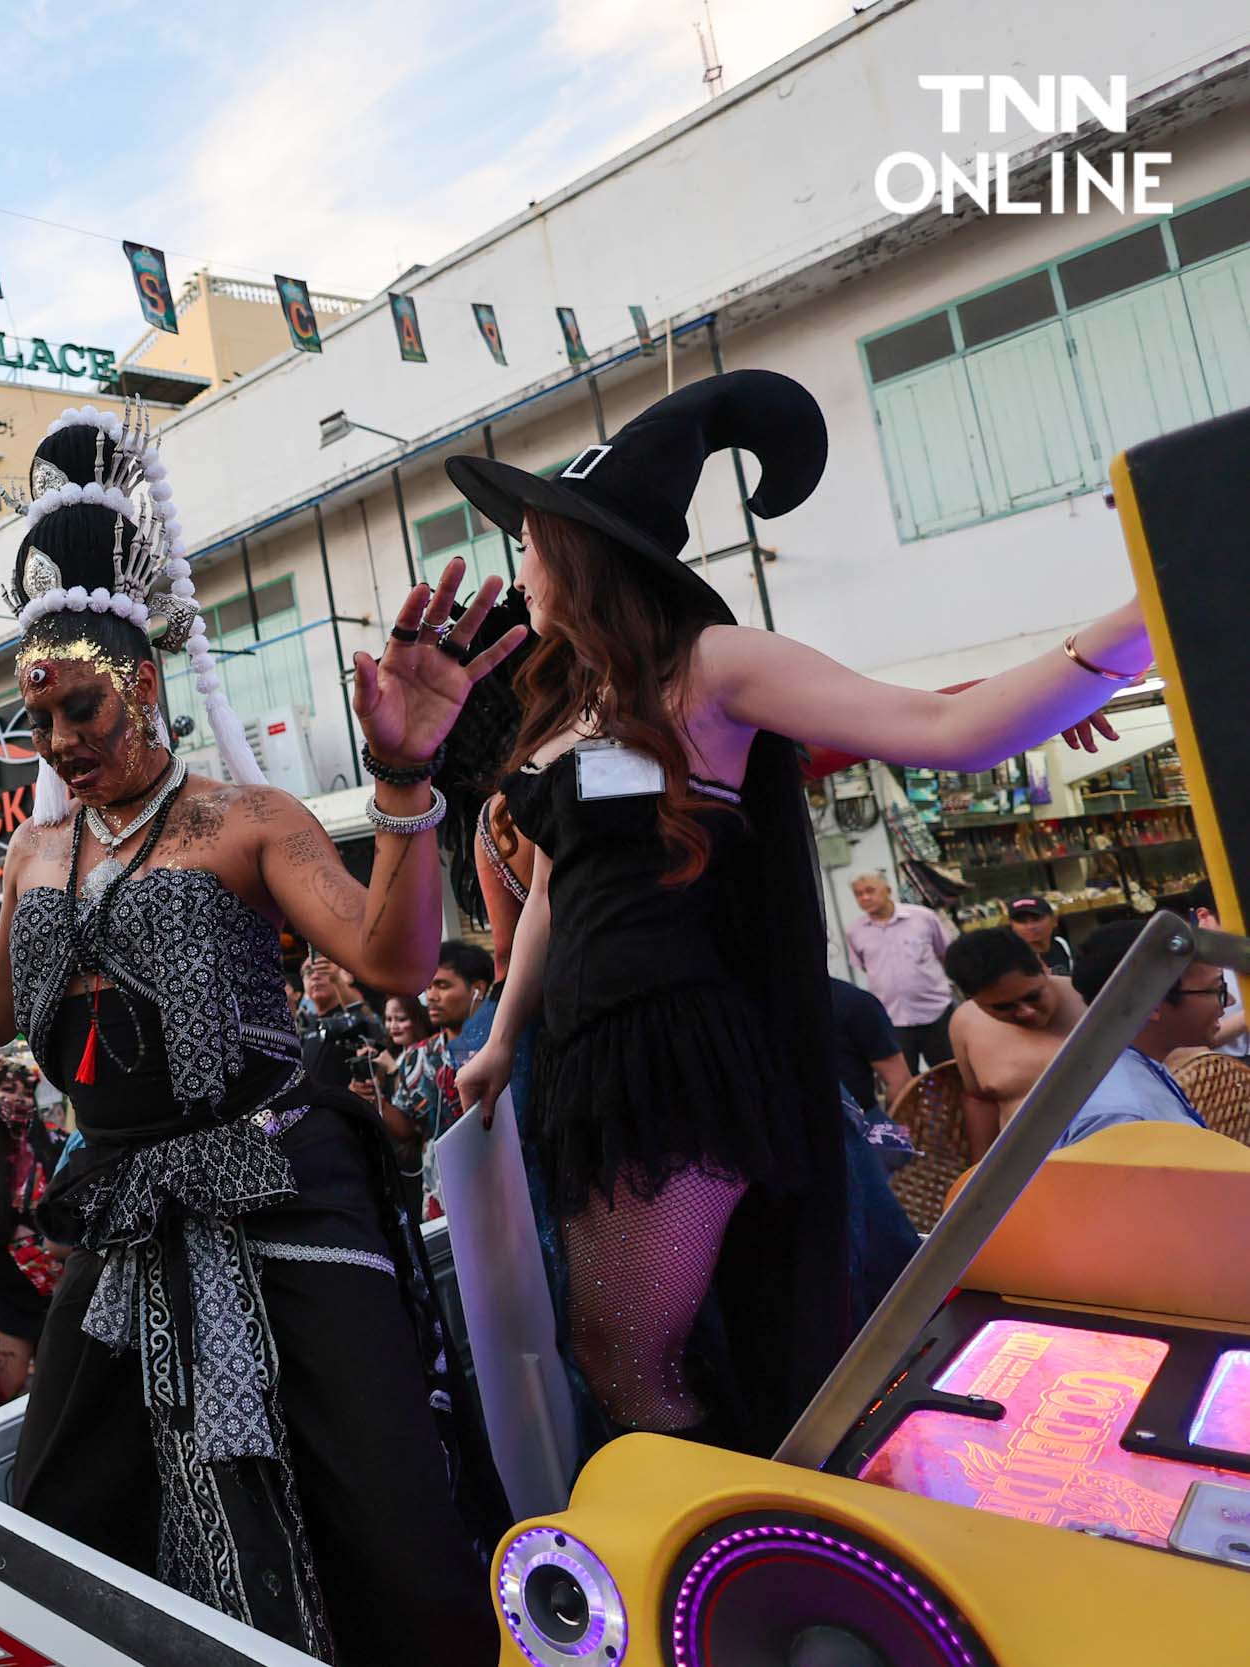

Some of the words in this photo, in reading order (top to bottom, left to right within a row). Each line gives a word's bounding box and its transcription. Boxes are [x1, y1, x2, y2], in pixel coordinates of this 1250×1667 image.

[139, 272, 165, 316] S
[289, 301, 314, 339] C
[401, 313, 421, 353] A
